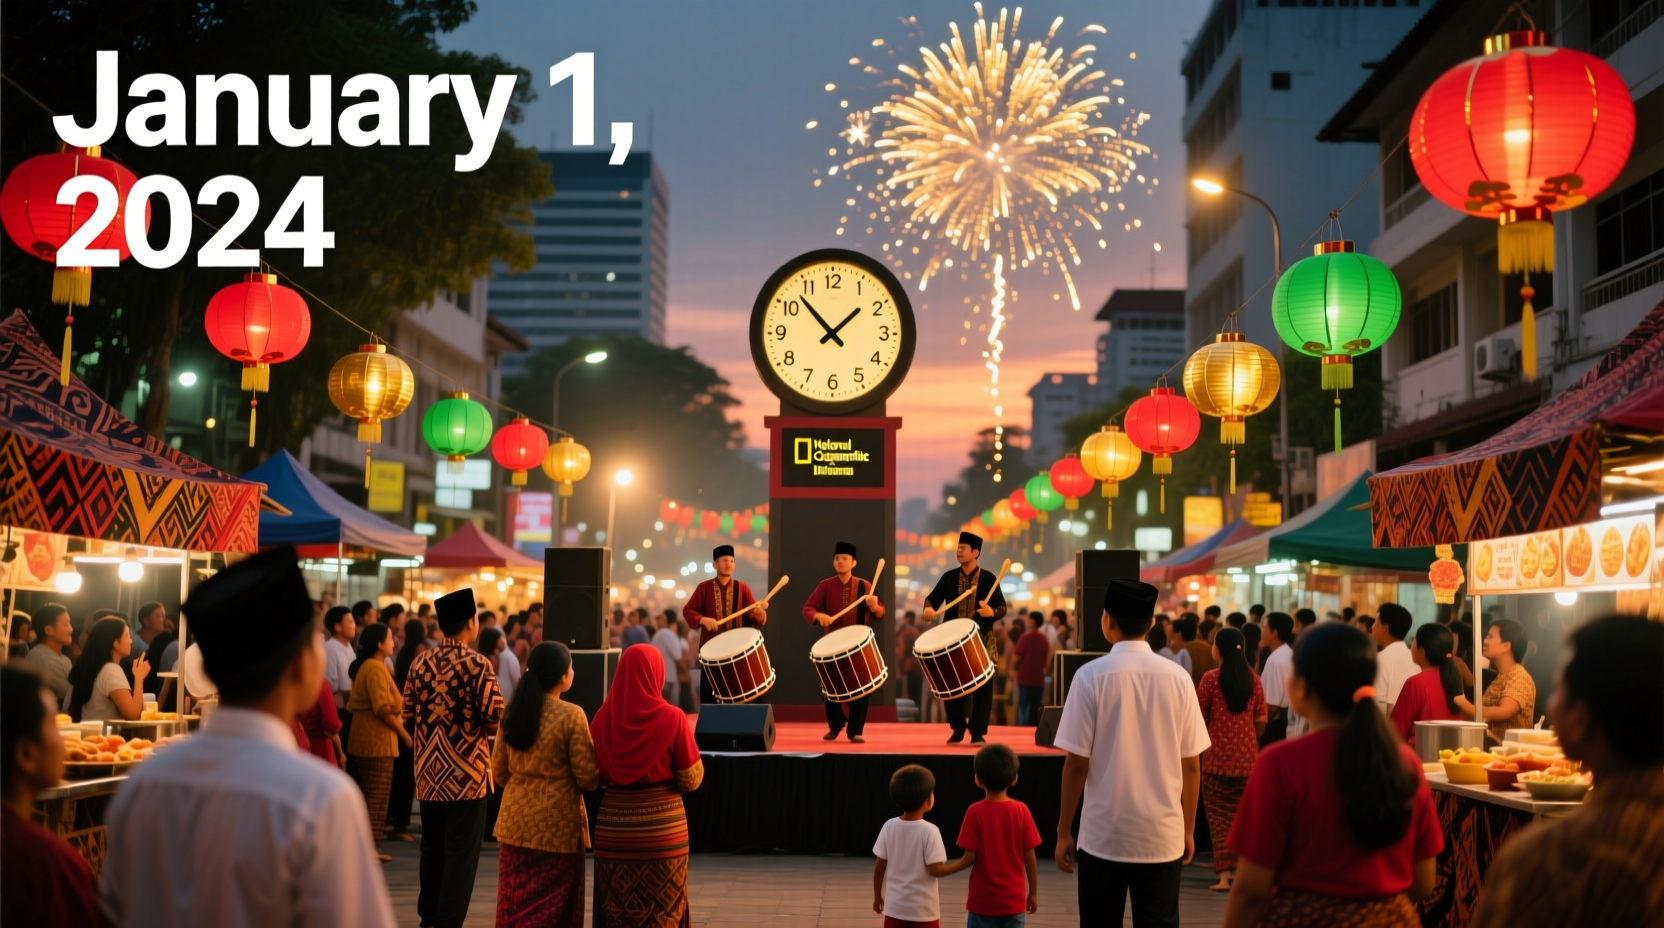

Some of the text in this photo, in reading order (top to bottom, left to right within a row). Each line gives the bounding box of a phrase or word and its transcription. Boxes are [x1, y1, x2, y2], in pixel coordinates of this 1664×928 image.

[803, 279, 815, 295] 11
[826, 274, 841, 289] 12
[856, 280, 862, 295] 1
[784, 300, 799, 316] 10
[873, 301, 883, 317] 2
[776, 325, 787, 340] 9
[879, 326, 890, 341] 3
[784, 350, 795, 366] 8
[870, 350, 882, 365] 4
[803, 368, 814, 383] 7
[828, 374, 838, 390] 6
[854, 367, 865, 383] 5
